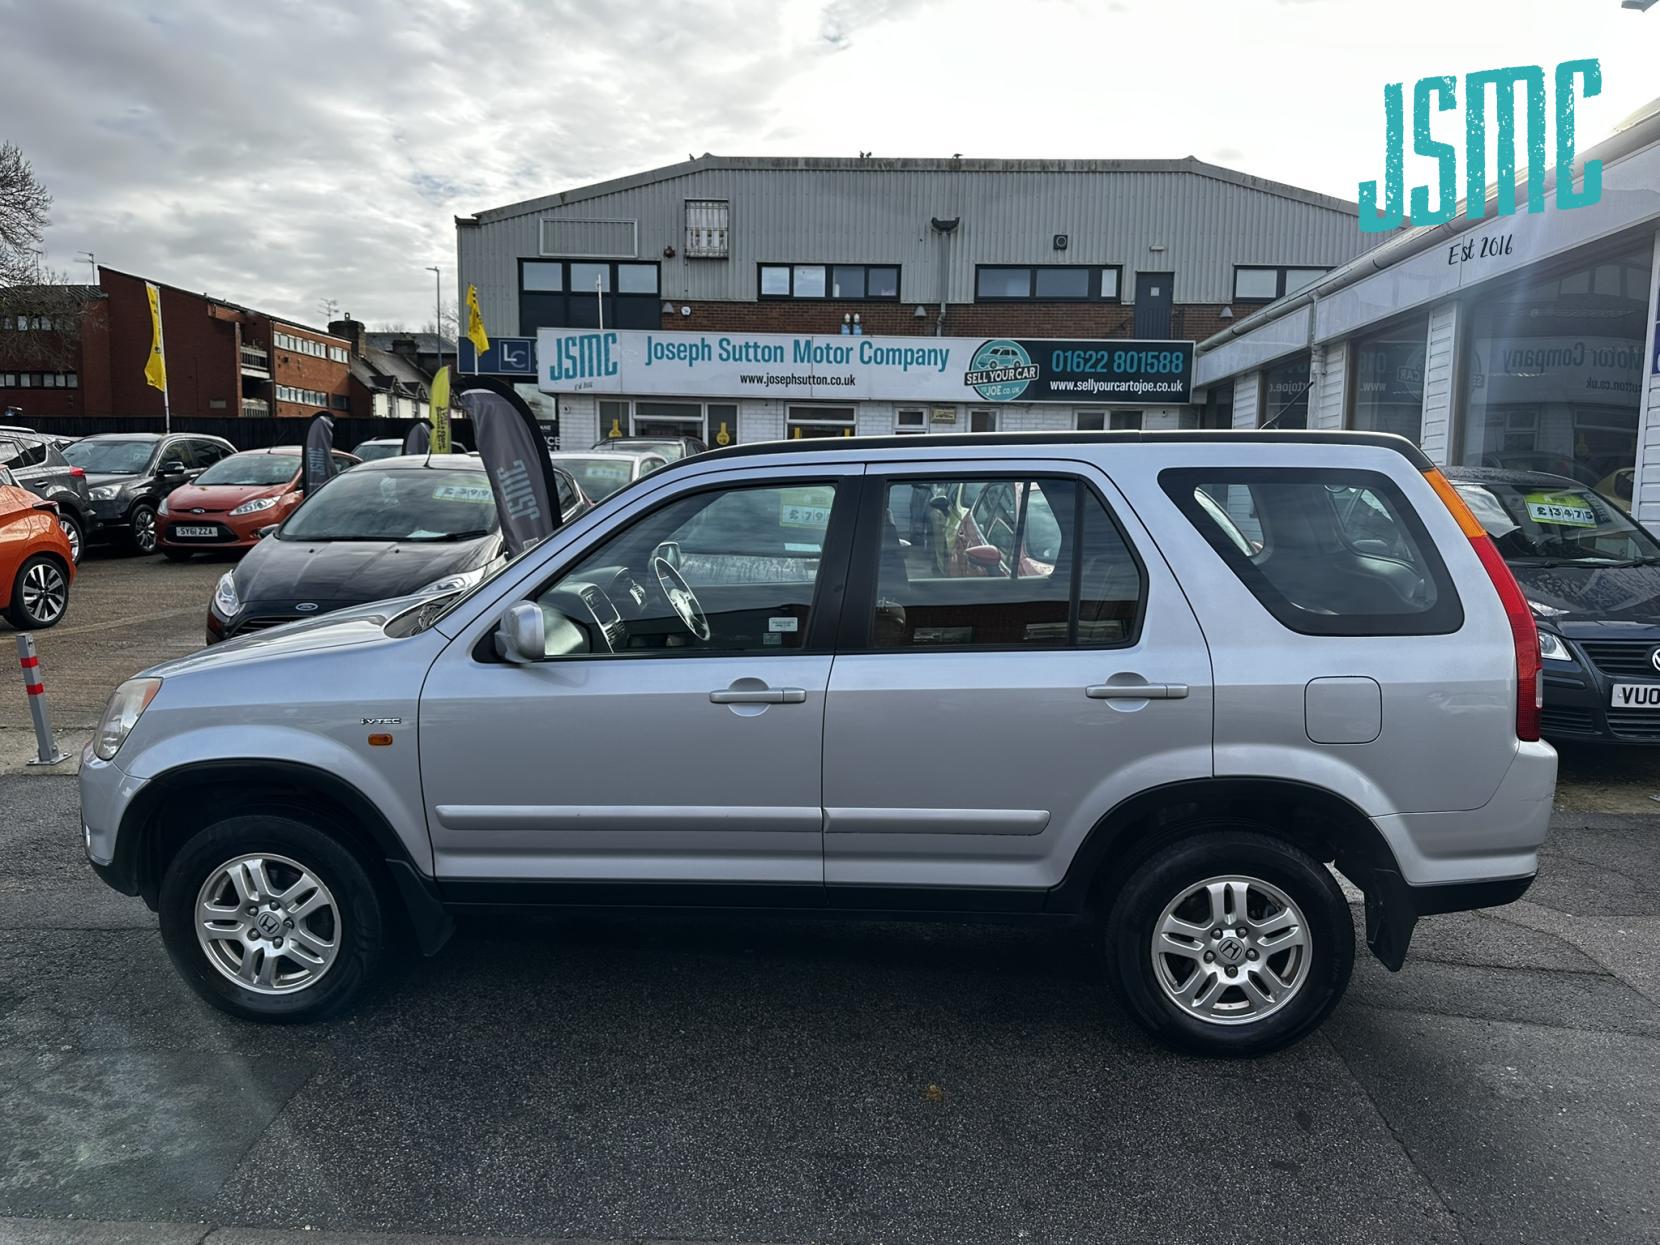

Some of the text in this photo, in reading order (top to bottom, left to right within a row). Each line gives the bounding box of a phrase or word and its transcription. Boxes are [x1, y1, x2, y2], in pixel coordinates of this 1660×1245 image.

[1448, 234, 1513, 266] Est 2016
[550, 333, 618, 381] JSMC
[645, 336, 950, 372] Joseph Sutton Motor Company
[1052, 350, 1184, 374] 01622 801588
[740, 372, 855, 388] www.josephsutton.co.uk
[966, 366, 1036, 385] SELL YOUR CAR
[1050, 379, 1183, 395] www.sellyourcartojoe.co.uk
[789, 509, 825, 521] £79
[1537, 506, 1594, 520] £13475
